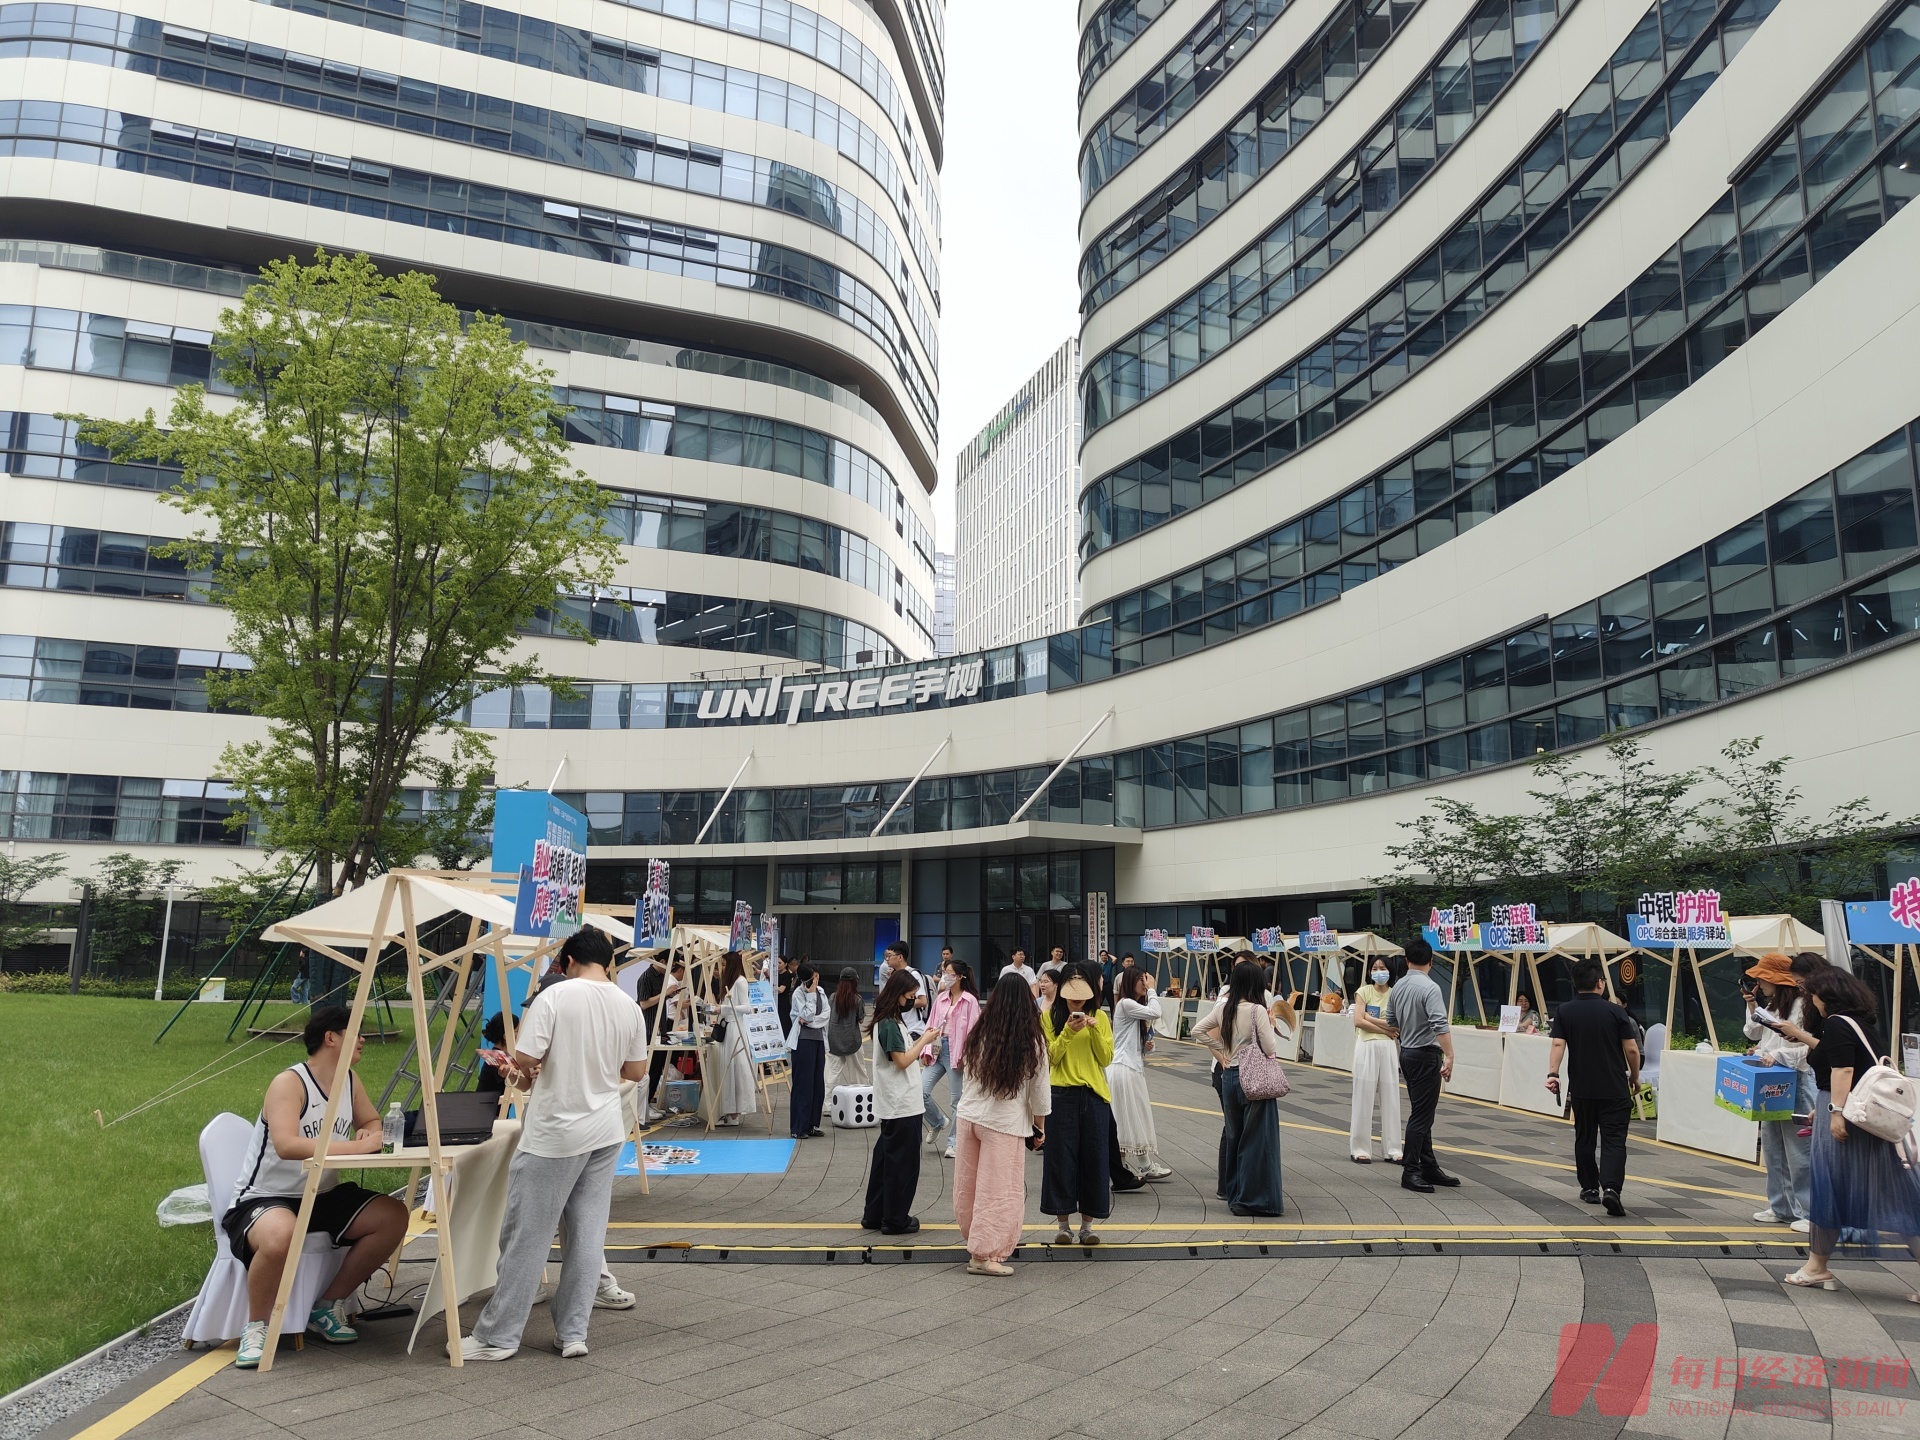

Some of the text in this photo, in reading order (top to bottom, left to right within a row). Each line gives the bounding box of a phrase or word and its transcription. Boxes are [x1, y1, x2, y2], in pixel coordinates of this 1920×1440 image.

[1639, 890, 1723, 924] 中银护航
[1099, 897, 1107, 949] 杭州高新科创集
[1636, 926, 1726, 942] OPC综合金融服务驿站
[1437, 924, 1468, 948] 创想集市
[1489, 924, 1546, 947] OPC法律驿站
